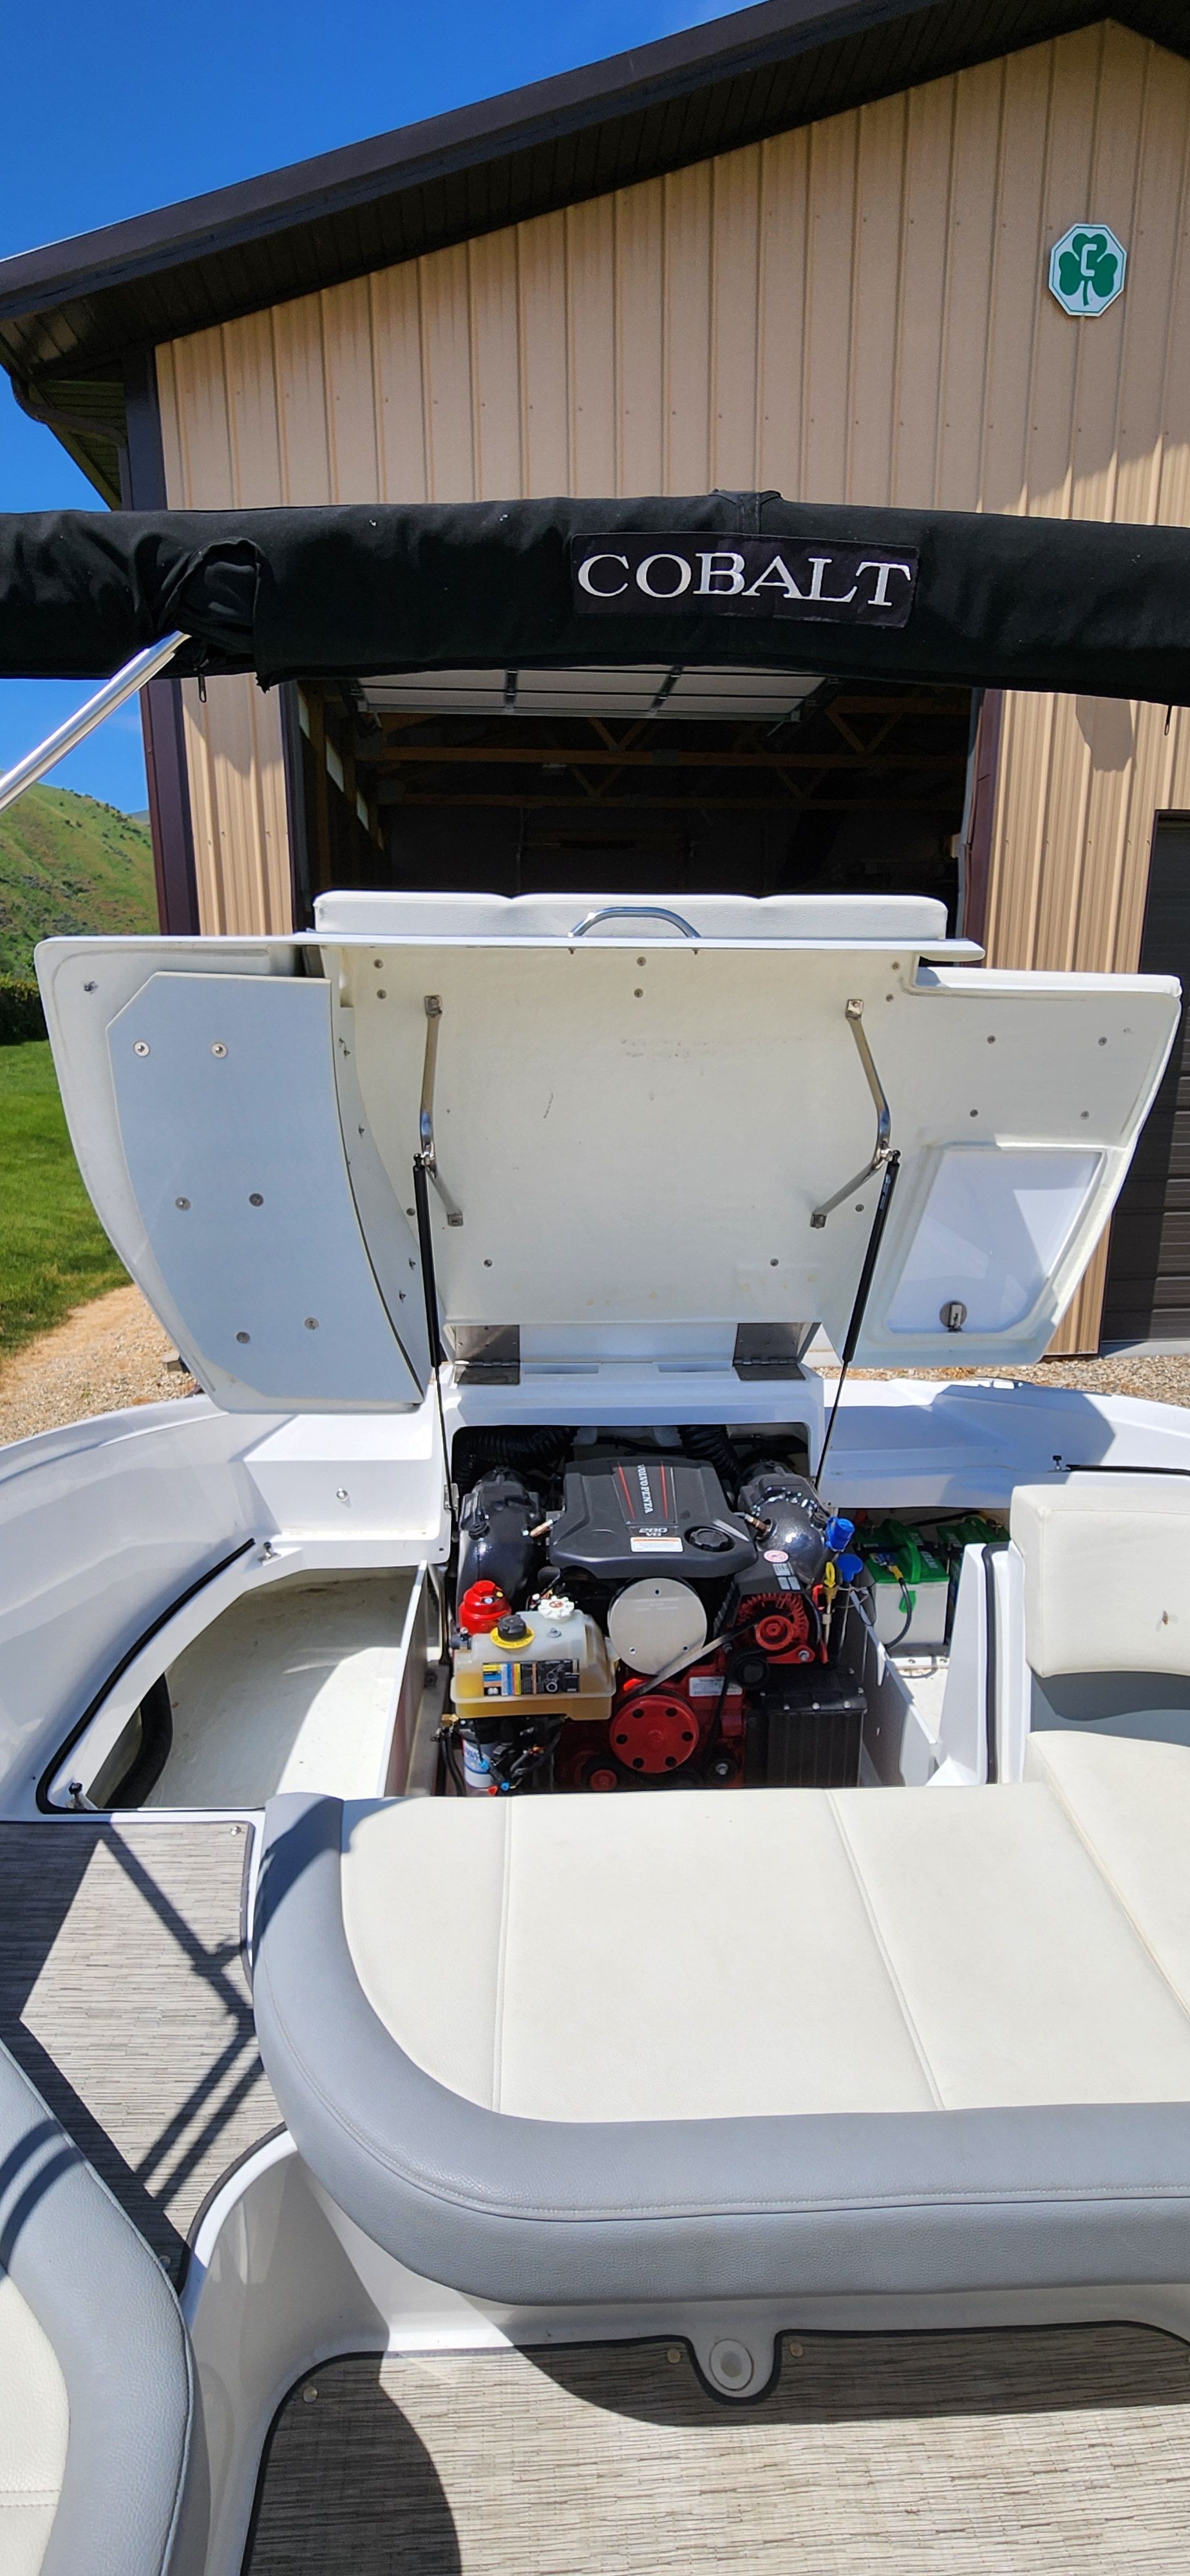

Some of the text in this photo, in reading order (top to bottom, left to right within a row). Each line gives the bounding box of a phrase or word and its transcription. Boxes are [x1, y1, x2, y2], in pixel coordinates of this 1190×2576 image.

[1081, 243, 1097, 277] C
[578, 552, 912, 607] COBALT
[637, 1464, 654, 1513] VOLVO PENTA
